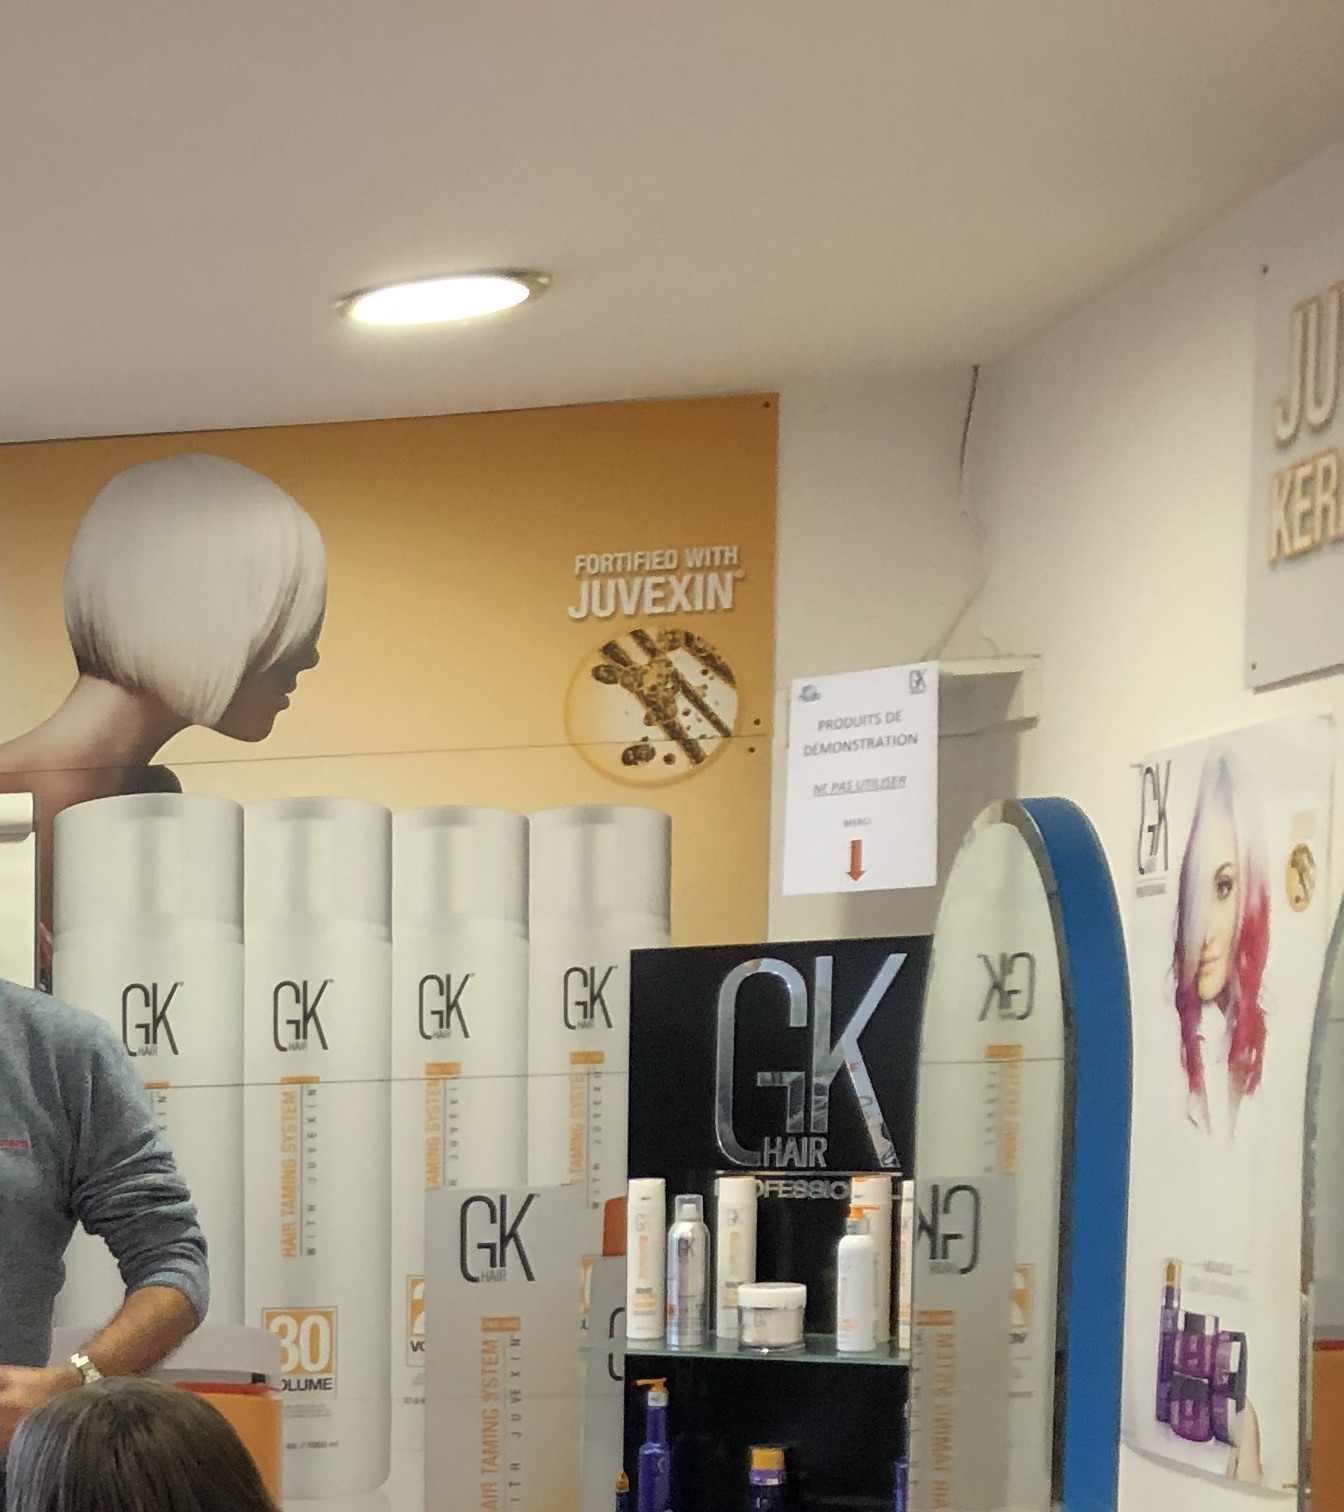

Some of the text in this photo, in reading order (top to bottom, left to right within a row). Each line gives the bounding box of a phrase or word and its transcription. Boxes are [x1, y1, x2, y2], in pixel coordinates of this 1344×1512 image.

[573, 546, 739, 575] FORTIFIED WITH
[567, 572, 734, 619] JUVEXIN
[817, 709, 903, 731] PRODUITS DE
[813, 775, 907, 794] NE PAS UTILISER
[843, 817, 872, 828] MERCI
[122, 982, 179, 1057] GK
[274, 979, 329, 1052] GK
[419, 974, 470, 1039] GK
[563, 966, 613, 1030] GK
[715, 953, 907, 1169] GK
[763, 1136, 827, 1168] HAIR
[460, 1193, 535, 1282] GK
[481, 1268, 506, 1282] HAIR
[269, 1313, 331, 1373] 30
[481, 1339, 499, 1402] SYSTEM
[510, 1337, 522, 1438] JUVEXIN
[481, 1408, 499, 1476] TAMING
